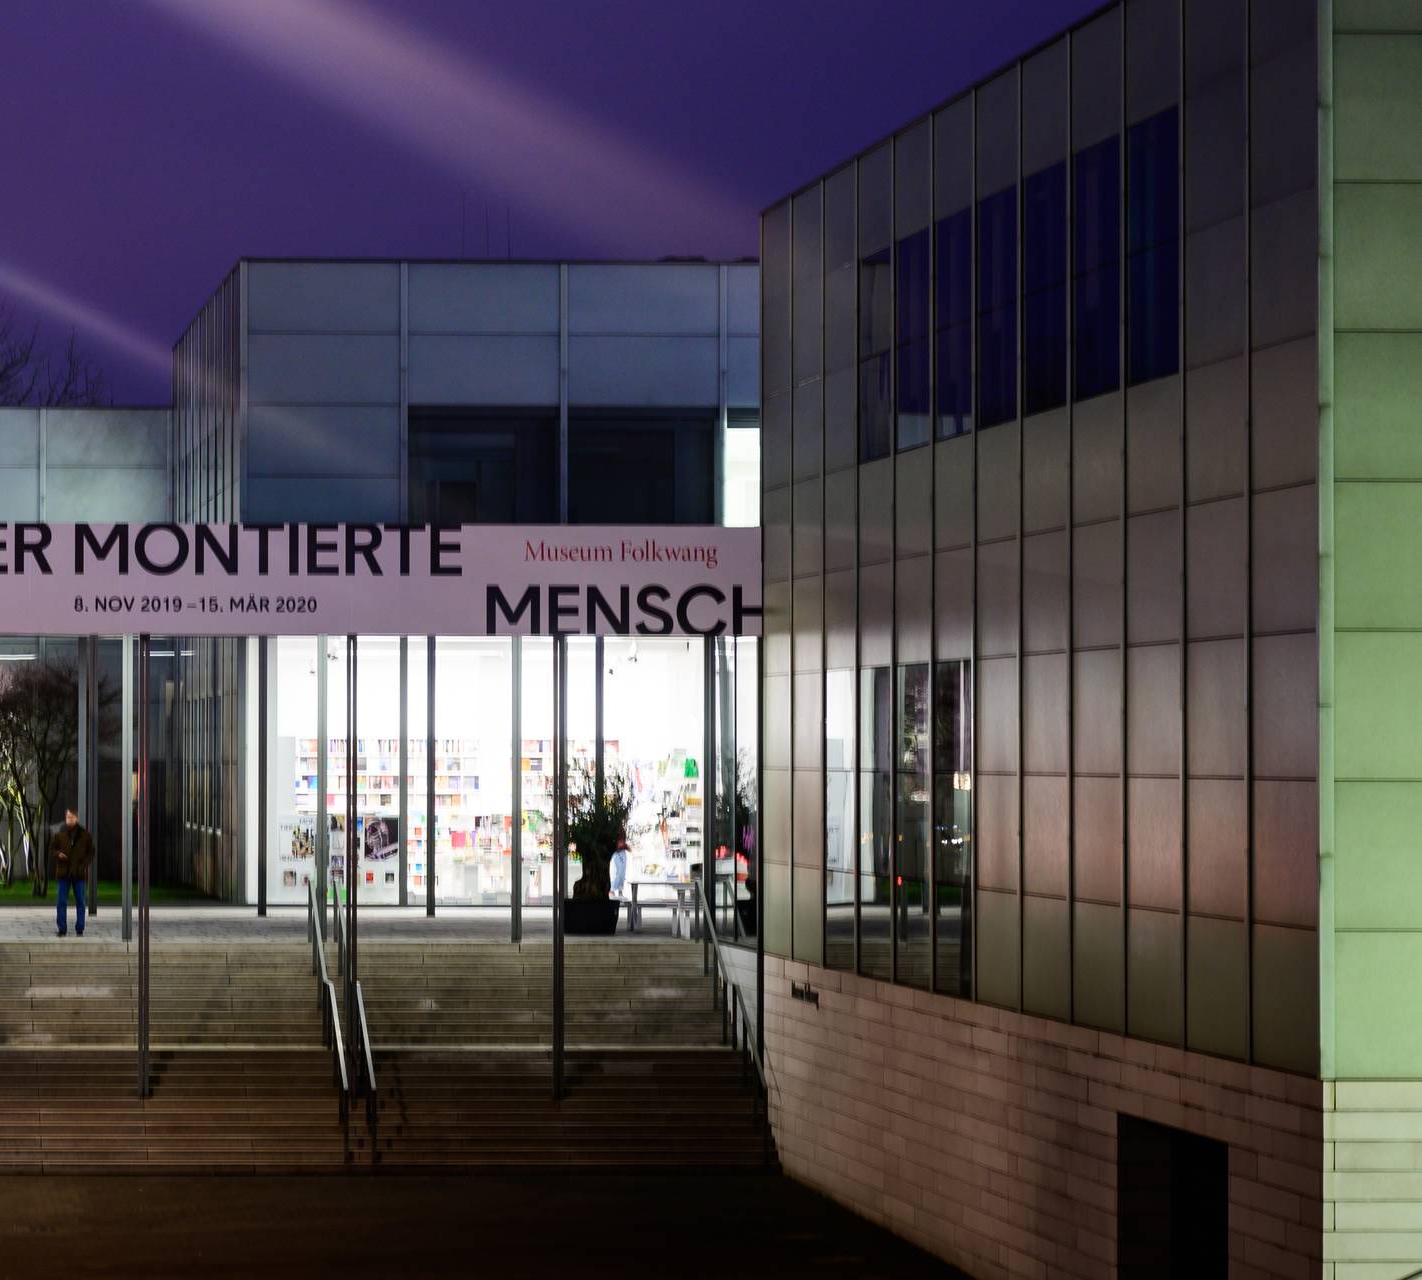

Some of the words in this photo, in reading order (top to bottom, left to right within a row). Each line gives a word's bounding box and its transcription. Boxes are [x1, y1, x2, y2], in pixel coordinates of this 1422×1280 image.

[74, 523, 463, 577] MONTIERTE
[524, 540, 614, 563] Museum
[620, 539, 719, 569] Folkwang
[73, 596, 90, 613] 8.
[94, 597, 136, 613] NOV
[140, 597, 183, 614] 2019
[229, 593, 271, 613] MÄR
[275, 597, 318, 614] 2020
[485, 583, 764, 636] MENSCH
